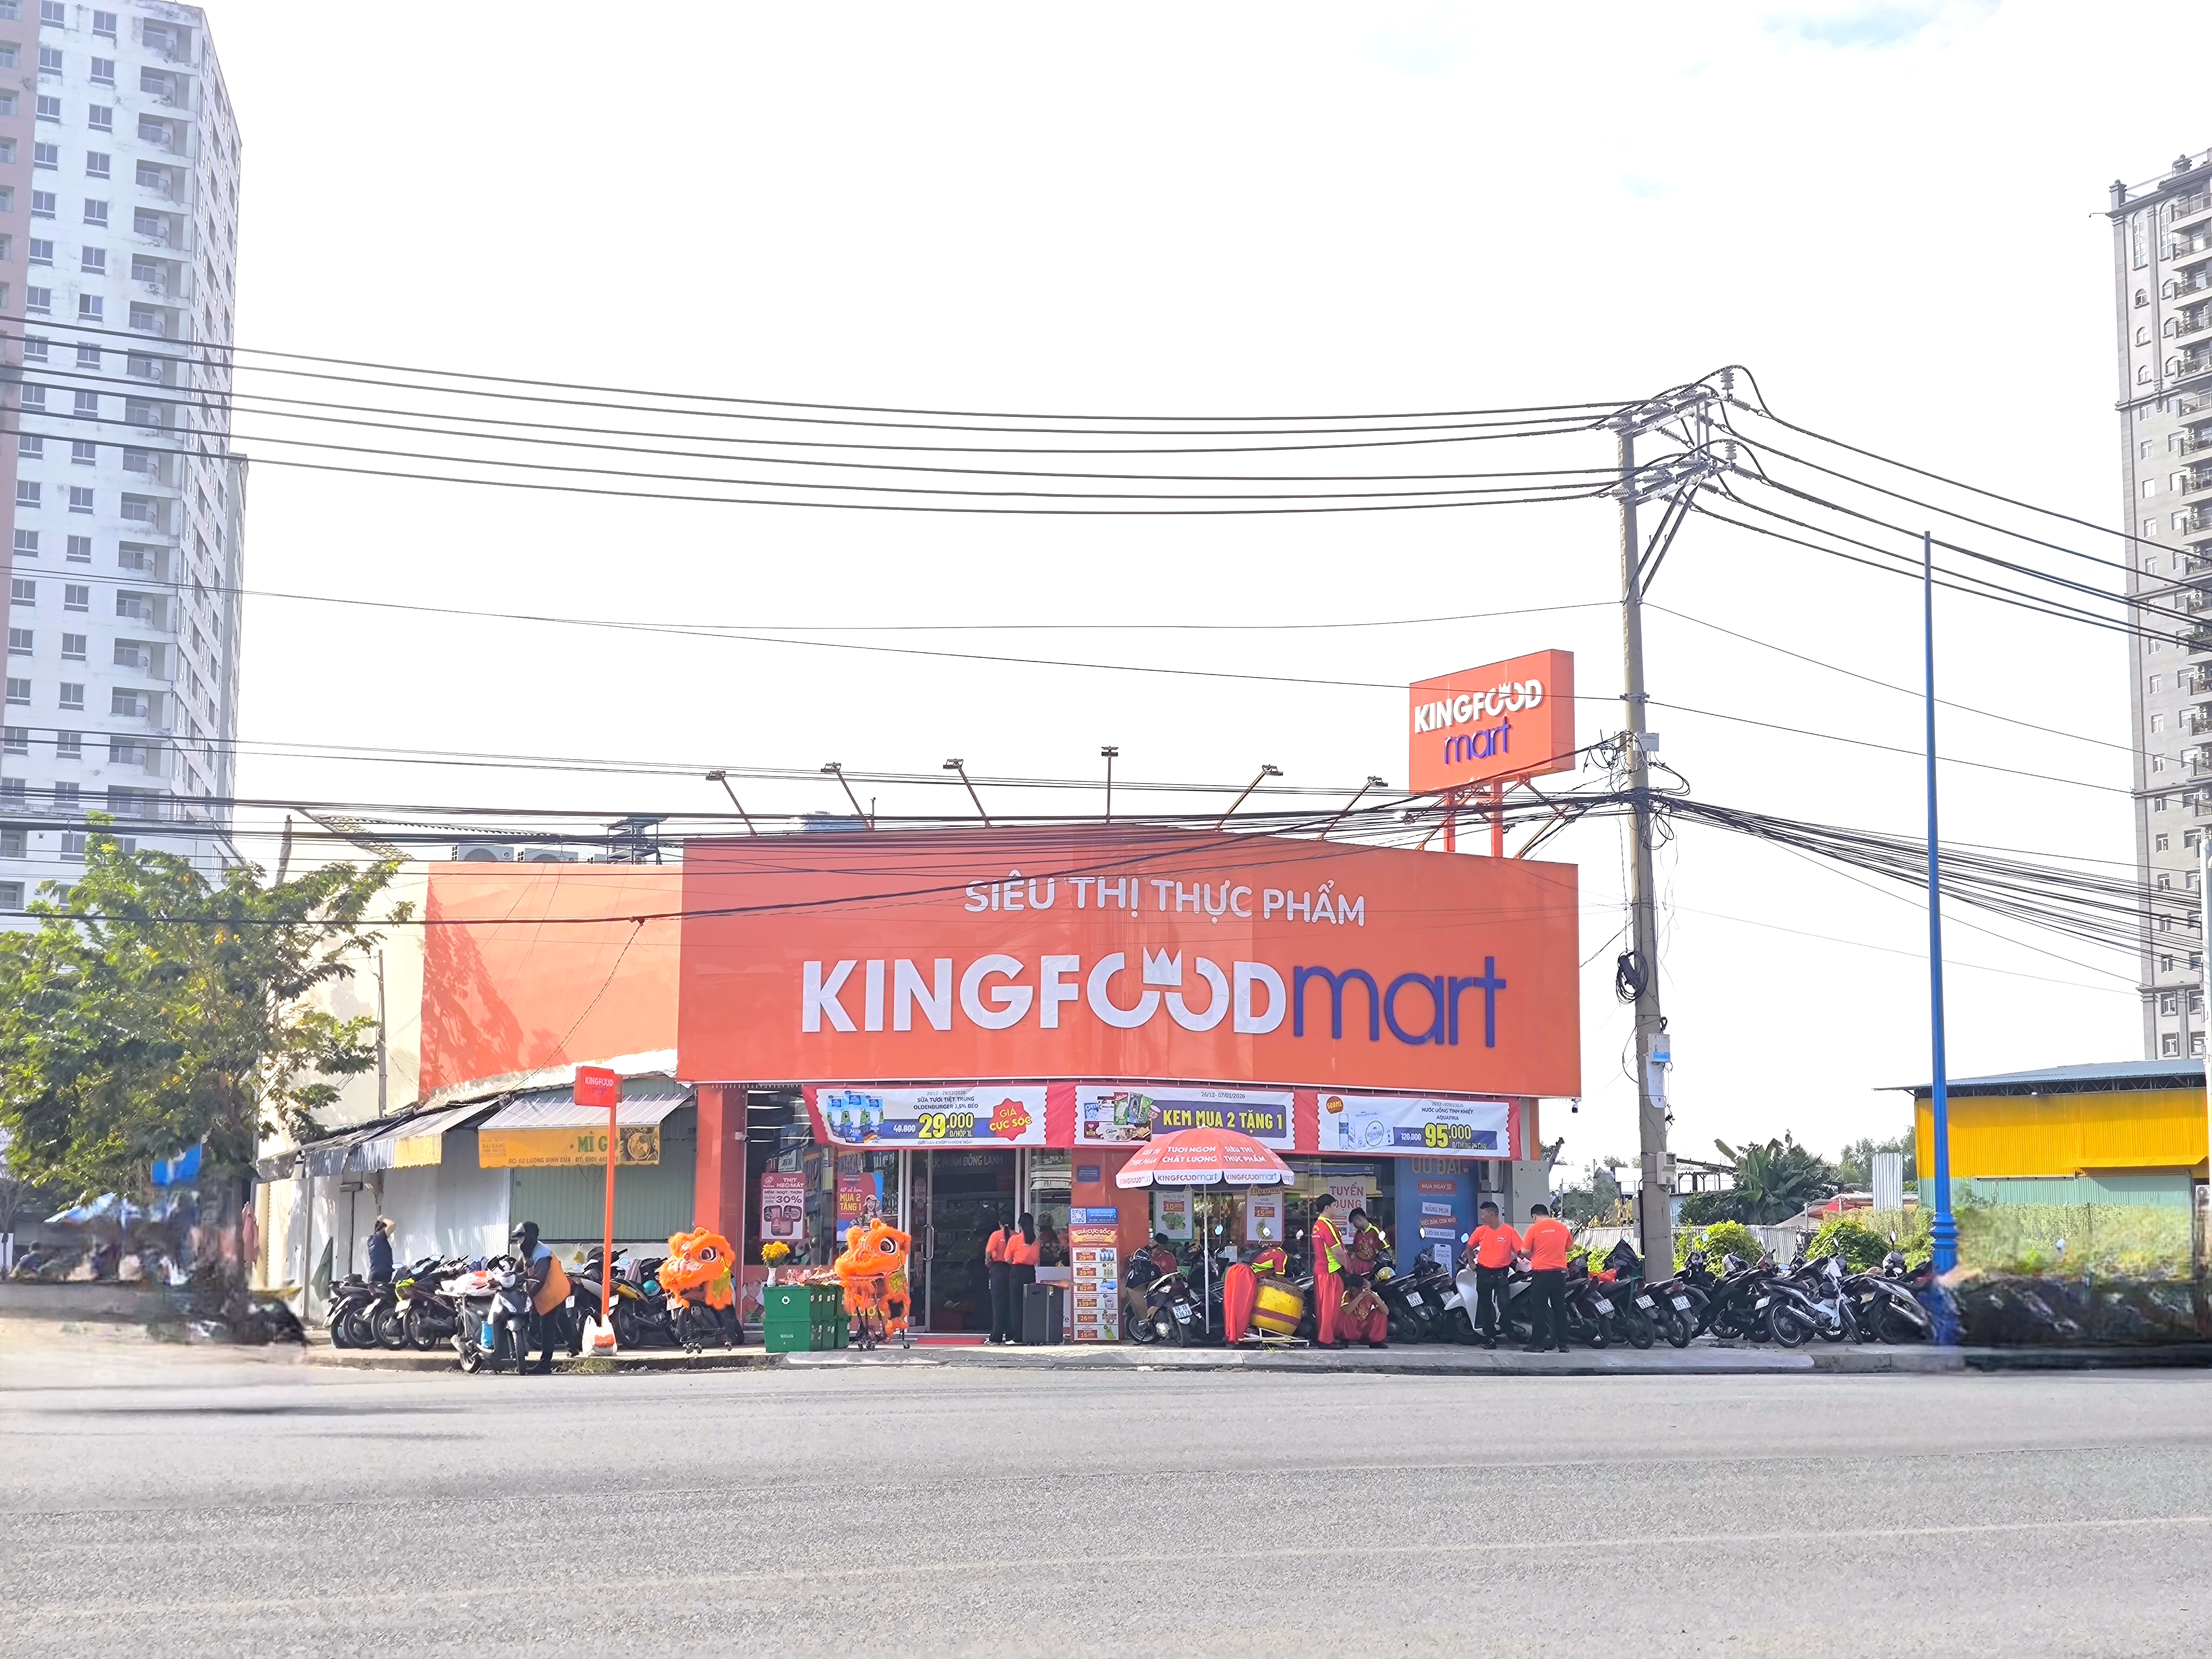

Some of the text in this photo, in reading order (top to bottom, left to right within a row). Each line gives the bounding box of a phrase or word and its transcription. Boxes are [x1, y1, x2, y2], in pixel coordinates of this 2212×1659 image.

[1414, 679, 1543, 733] KINGFOOD
[1444, 716, 1512, 765] mart
[963, 869, 1365, 927] SIÊU THỊ THỰC PHẨM
[585, 1076, 613, 1087] KINGFOOD
[1000, 1105, 1017, 1118] GIÁ
[1327, 1101, 1343, 1109] 500ML
[989, 1115, 1033, 1132] CỰC SỐC
[1163, 1110, 1191, 1126] KEM
[1195, 1110, 1223, 1127] MUA
[1227, 1112, 1235, 1128] 2
[1239, 1109, 1273, 1134] TẶNG
[1277, 1114, 1282, 1129] 1
[577, 1131, 595, 1152] MÌ
[1162, 1155, 1217, 1163] CHẤT LƯỢNG
[1223, 1155, 1243, 1163] THỰC
[1243, 1153, 1267, 1163] PHẨM
[1330, 1182, 1364, 1196] TUYỂN
[776, 1196, 802, 1204] 30%
[840, 1193, 861, 1202] MUA 2
[840, 1202, 861, 1212] TẶNG 1
